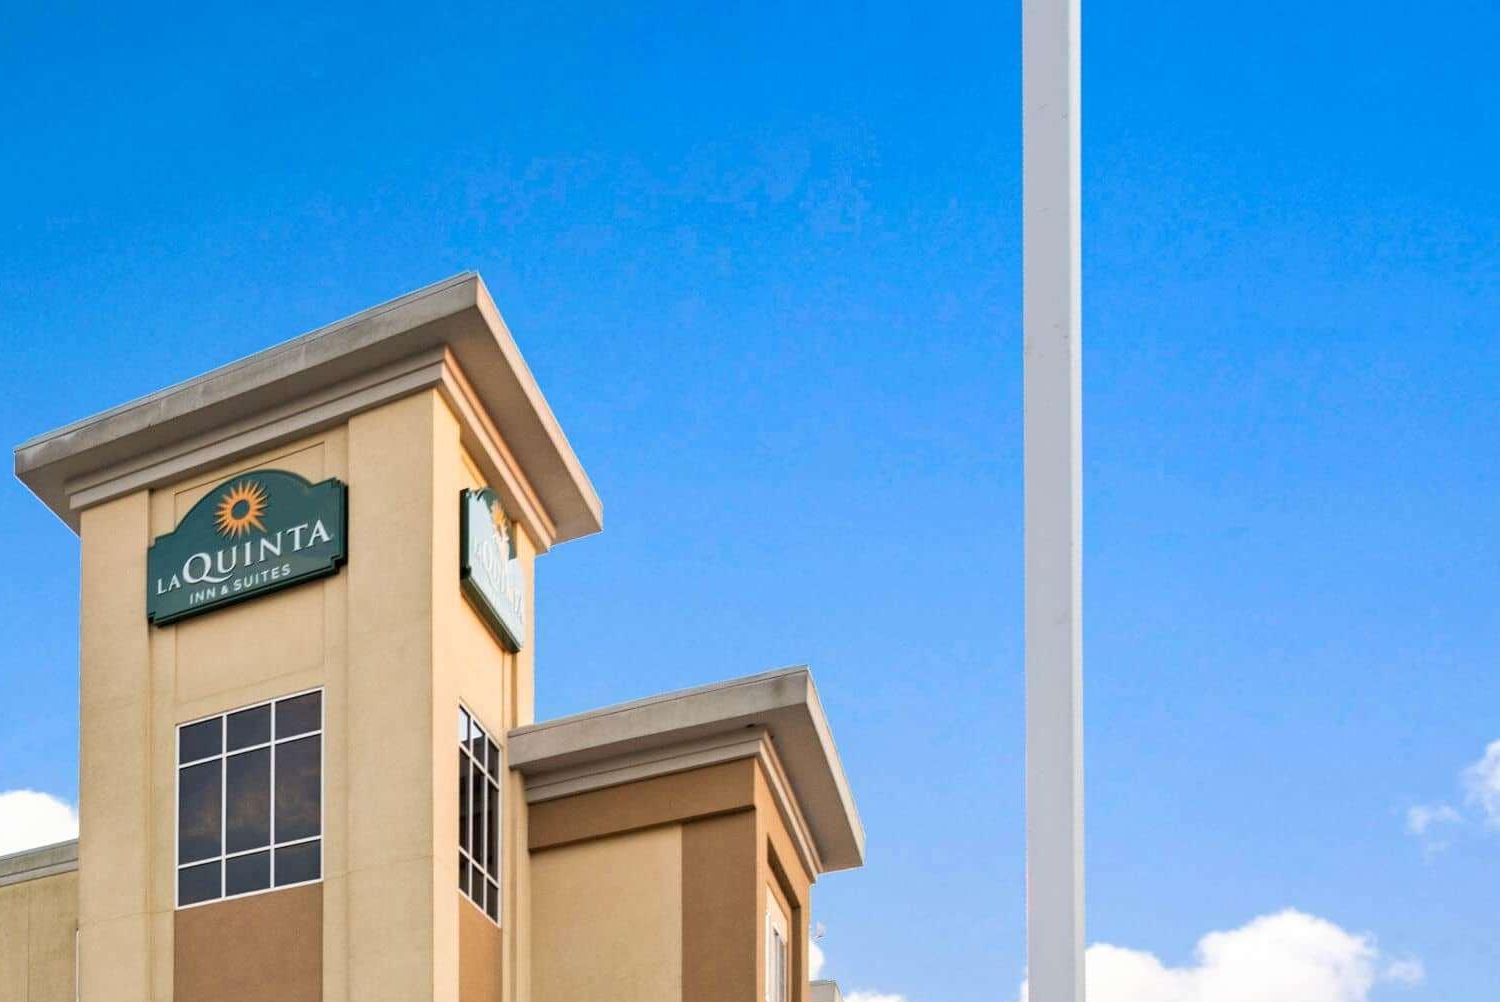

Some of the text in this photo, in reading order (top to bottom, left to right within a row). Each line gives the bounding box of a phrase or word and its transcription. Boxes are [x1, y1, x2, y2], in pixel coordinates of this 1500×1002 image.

[156, 519, 332, 595] LA QUINTA
[189, 563, 292, 605] INN & SUITES
